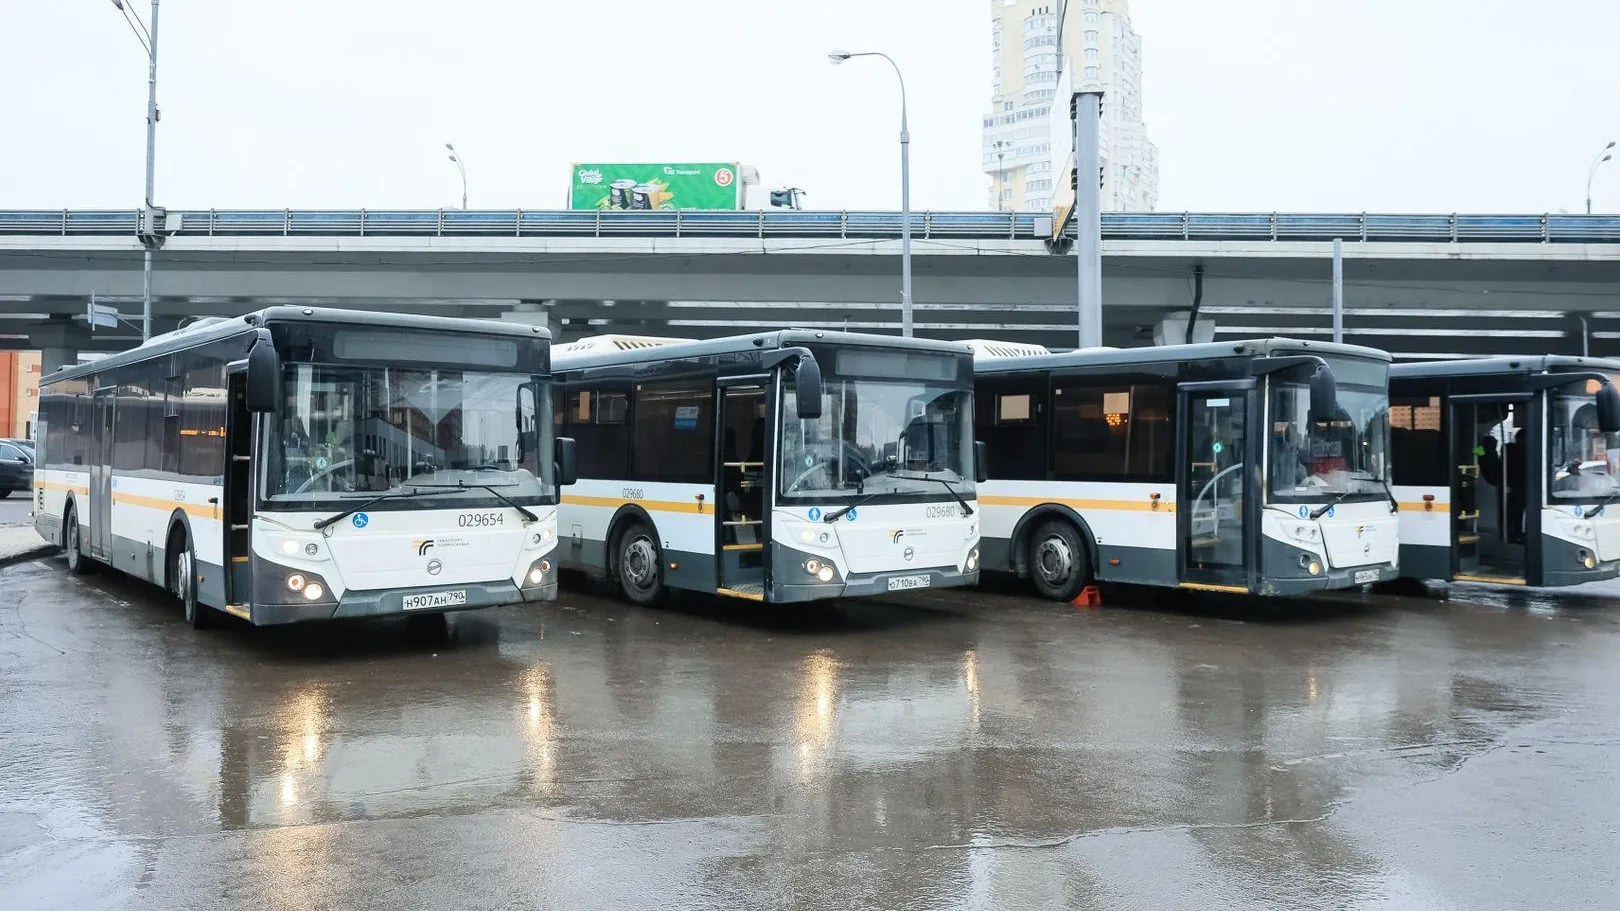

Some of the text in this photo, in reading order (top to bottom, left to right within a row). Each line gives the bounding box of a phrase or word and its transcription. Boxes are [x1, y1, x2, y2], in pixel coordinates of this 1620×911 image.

[623, 487, 644, 499] 029680
[926, 505, 955, 518] 029680
[458, 512, 504, 528] 029654
[406, 595, 447, 608] Н907АН
